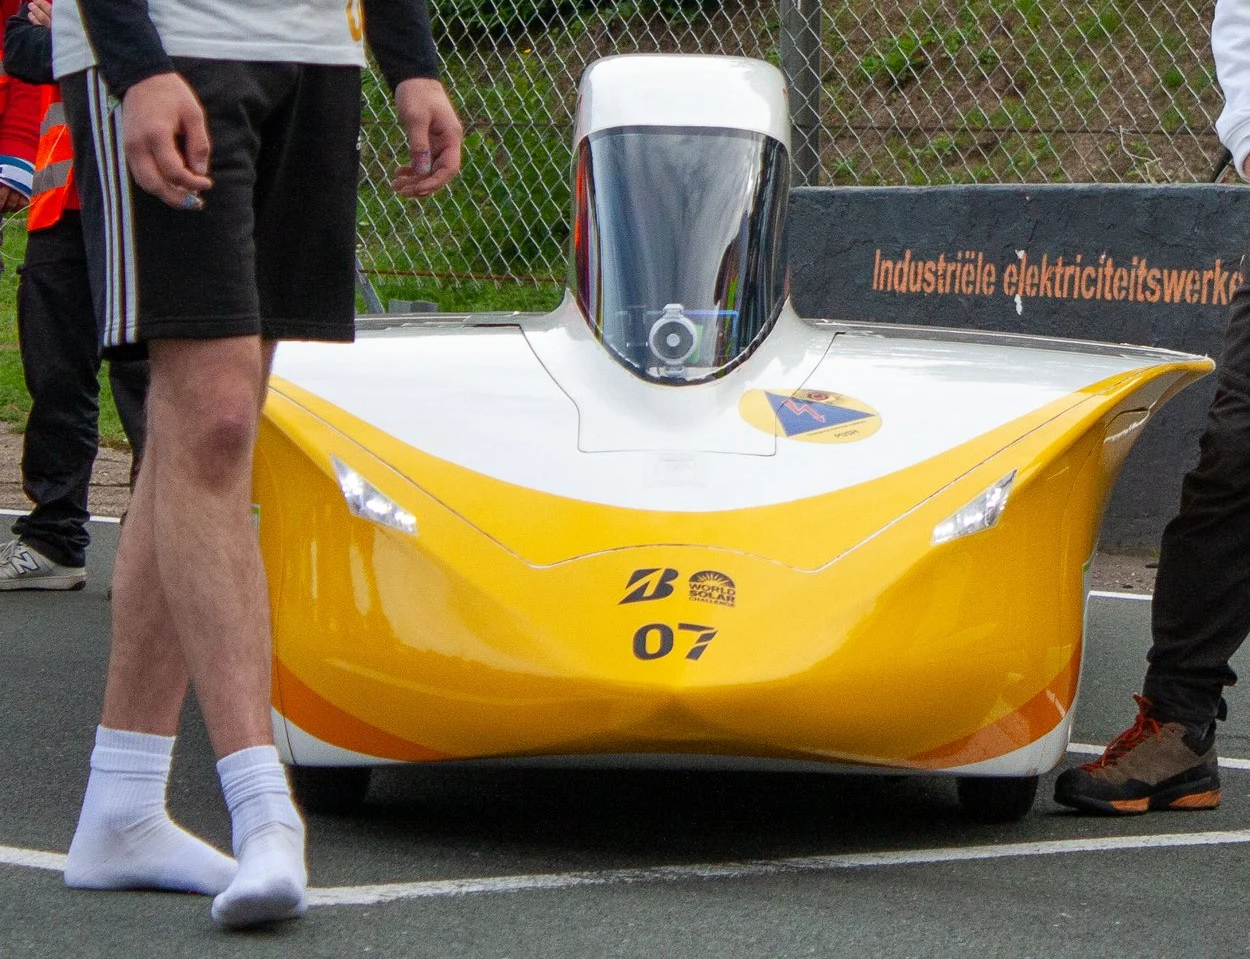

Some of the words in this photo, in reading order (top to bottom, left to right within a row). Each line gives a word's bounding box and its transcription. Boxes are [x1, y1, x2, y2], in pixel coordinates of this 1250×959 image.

[872, 248, 997, 295] Industriële
[688, 582, 736, 596] WORLD
[688, 589, 736, 603] SOLAR
[632, 622, 719, 661] 07
